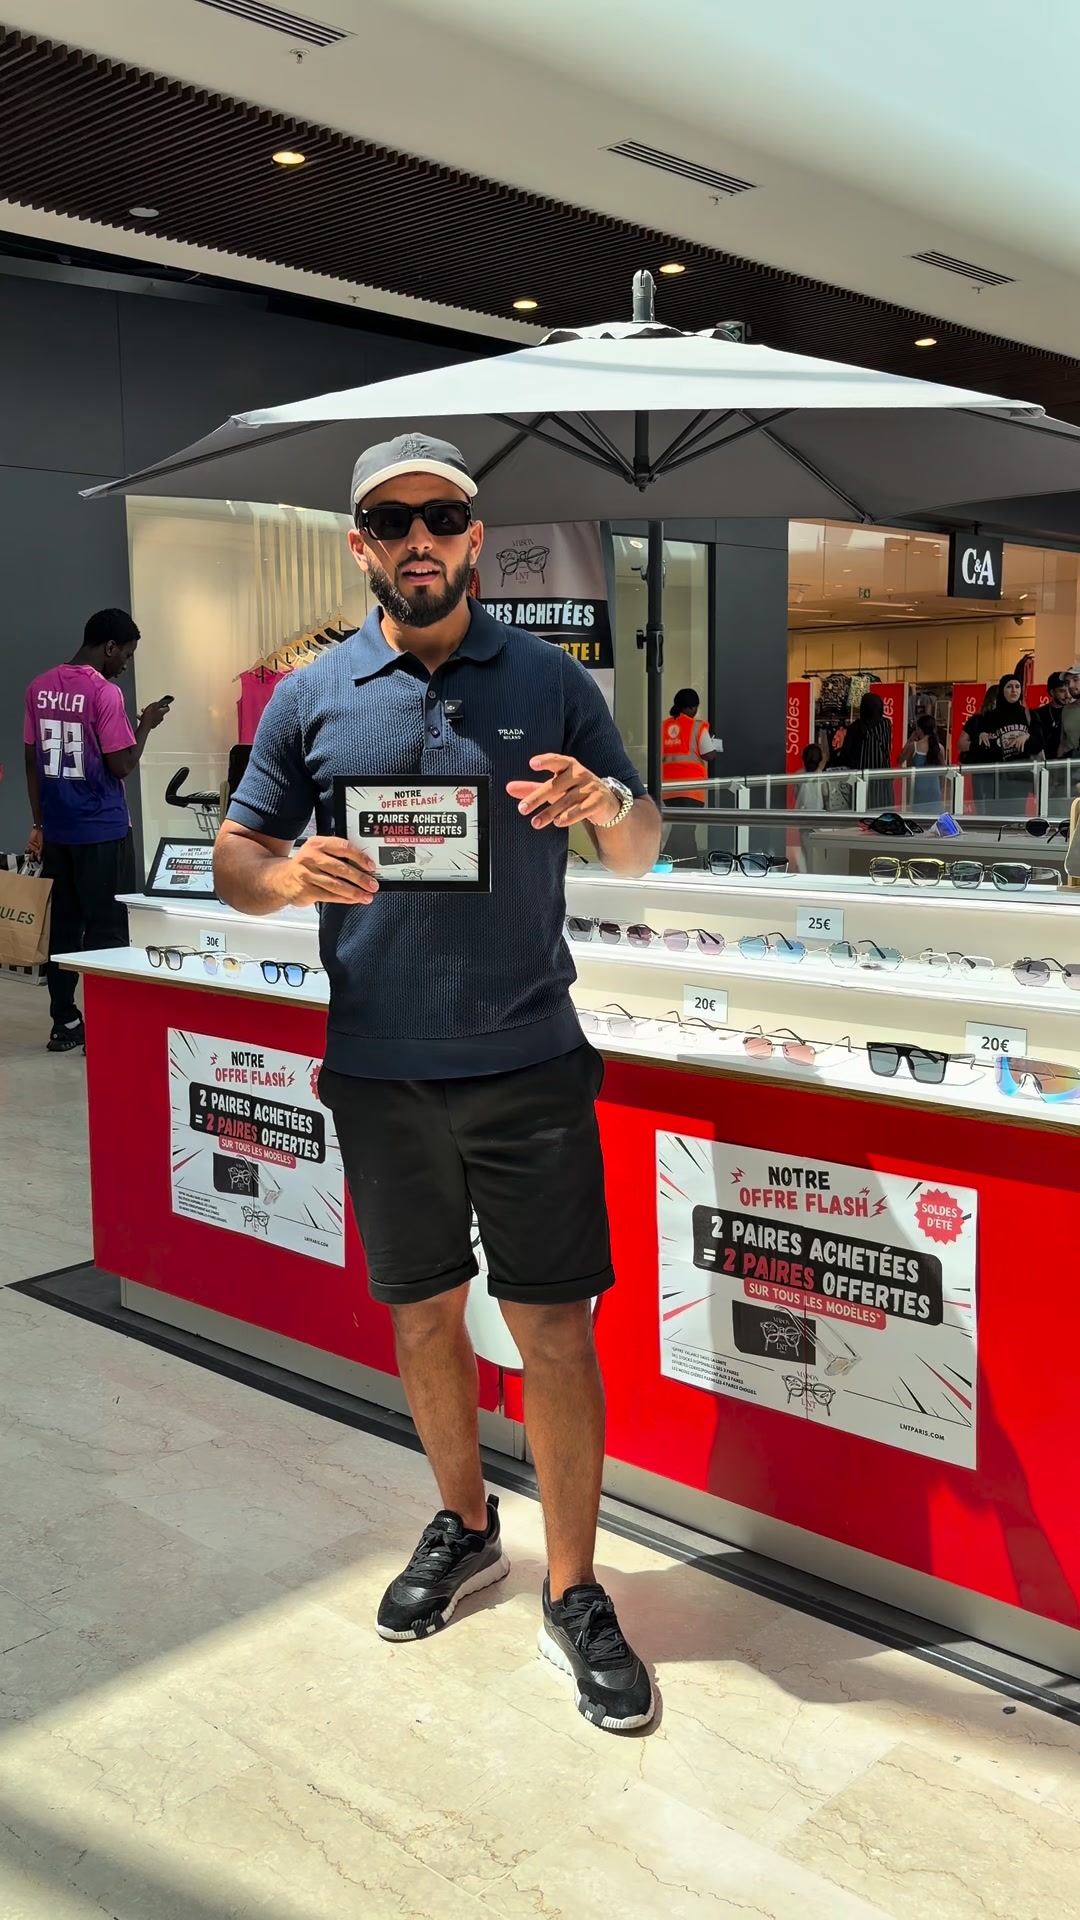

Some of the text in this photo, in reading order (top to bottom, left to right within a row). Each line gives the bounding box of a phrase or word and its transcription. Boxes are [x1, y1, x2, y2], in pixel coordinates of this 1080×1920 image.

[962, 548, 995, 586] C&A
[515, 600, 595, 627] ACHETÉES
[37, 690, 85, 713] SYLLA
[497, 728, 525, 736] PRADA
[786, 696, 800, 756] Soldes
[40, 718, 86, 781] 99
[381, 796, 438, 809] OFFRE FLASH
[394, 789, 422, 800] NOTRE
[367, 812, 458, 824] 2 PAIRES ACHETÉES
[373, 825, 380, 834] 2
[383, 825, 415, 834] PAIRES
[418, 825, 462, 835] OFFERTES
[808, 917, 832, 931] 25€
[206, 936, 220, 948] 30€
[694, 997, 716, 1012] 20€
[981, 1036, 1010, 1053] 20€
[231, 1051, 264, 1068] NOTRE
[215, 1068, 286, 1087] OFFRE FLASH
[199, 1089, 313, 1134] 2 PAIRES ACHETÉES
[206, 1113, 214, 1130] 2
[217, 1116, 258, 1142] PAIRES
[261, 1128, 319, 1160] OFFERTES
[221, 1138, 234, 1149] SUR
[235, 1141, 251, 1153] TOUS
[251, 1145, 263, 1157] LES
[768, 1166, 830, 1190] NOTRE
[739, 1187, 869, 1218] OFFRE FLASH
[921, 1203, 957, 1218] SOLDES
[927, 1216, 953, 1231] D'ÉTÉ
[711, 1215, 919, 1283] 2 PAIRES ACHETÉES
[723, 1248, 736, 1272] 2
[743, 1252, 815, 1291] PAIRES
[822, 1275, 931, 1319] OFFERTES
[749, 1283, 769, 1297] SUR
[772, 1287, 800, 1304] TOUS
[804, 1295, 823, 1309] LES
[899, 1423, 945, 1441] LNTPARIS.COM
